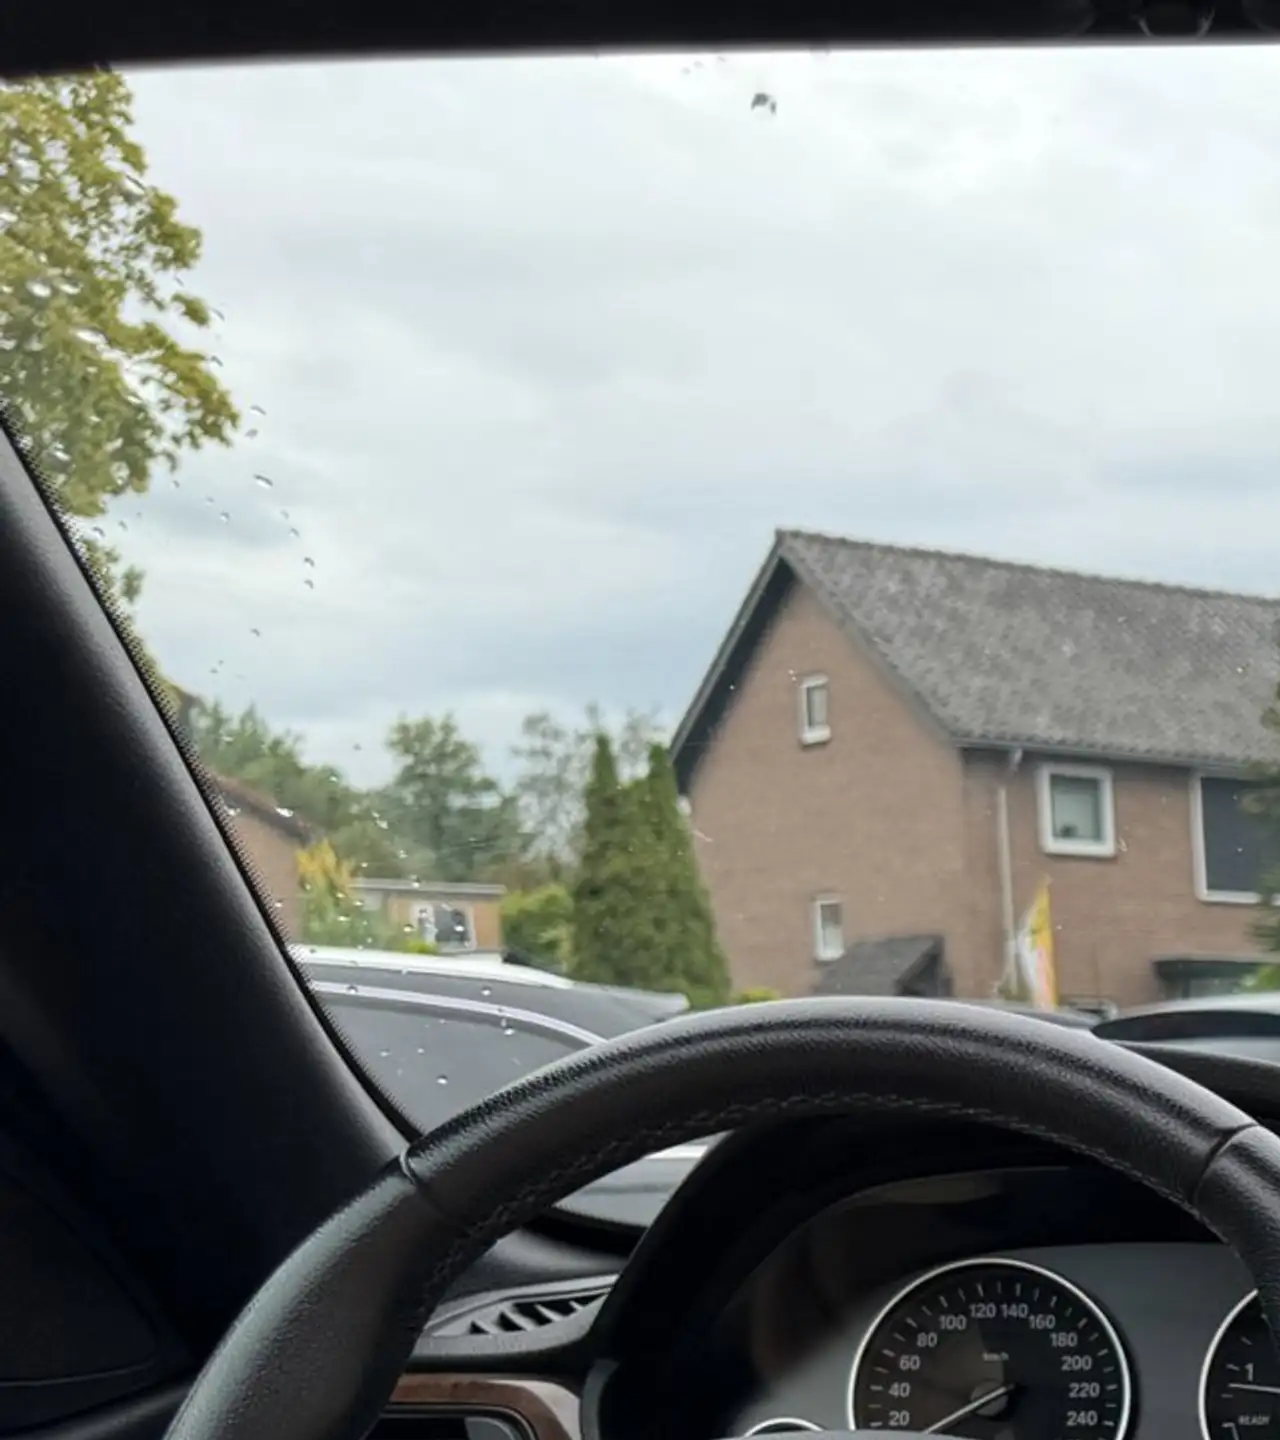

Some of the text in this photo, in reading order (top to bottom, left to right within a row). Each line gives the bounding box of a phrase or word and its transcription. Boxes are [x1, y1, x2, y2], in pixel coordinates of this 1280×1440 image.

[969, 1304, 997, 1318] 120
[1001, 1303, 1028, 1318] 140
[939, 1315, 967, 1330] 100
[1029, 1314, 1056, 1328] 160
[917, 1333, 937, 1347] 80
[1050, 1333, 1078, 1347] 180
[900, 1355, 921, 1370] 60
[1061, 1356, 1092, 1371] 200
[1244, 1363, 1254, 1380] 1
[889, 1382, 910, 1397] 40
[1069, 1383, 1100, 1398] 220
[888, 1411, 910, 1426] 20
[1067, 1411, 1098, 1426] 240
[1238, 1415, 1270, 1425] READY
